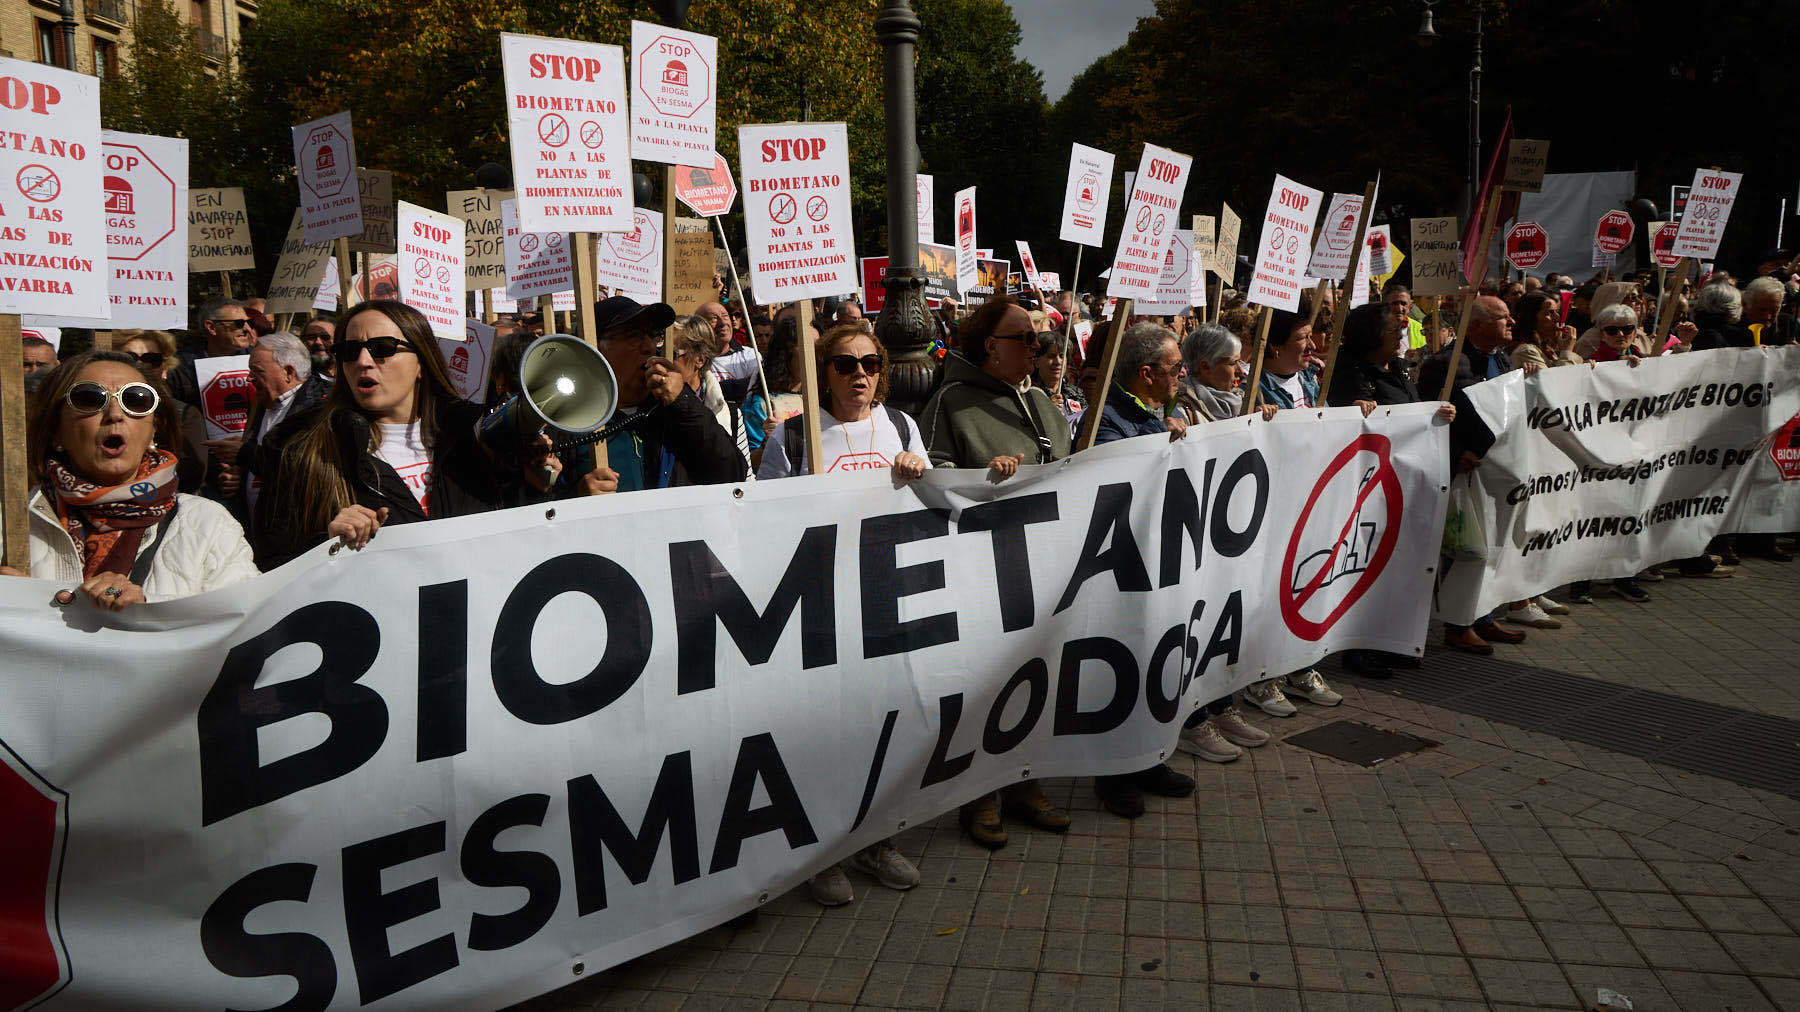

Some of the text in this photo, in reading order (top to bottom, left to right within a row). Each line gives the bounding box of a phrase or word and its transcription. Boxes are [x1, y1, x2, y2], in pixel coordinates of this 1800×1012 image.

[659, 42, 691, 58] STOP
[529, 53, 601, 82] STOP
[0, 76, 61, 115] OP
[661, 85, 689, 97] BIOGÁS
[516, 94, 616, 114] BIOMETANO
[657, 96, 693, 109] EN SESMA
[639, 117, 709, 134] NO A LA PLANTA
[311, 130, 334, 146] STOP
[636, 135, 710, 151] NAVARRA SE PLANTA
[539, 151, 606, 163] NO A LAS
[761, 138, 826, 163] STOP
[536, 168, 612, 180] PLANTAS DE
[1148, 158, 1180, 185] STOP
[750, 175, 840, 192] BIOMETANO
[1083, 177, 1096, 185] STOP
[1701, 175, 1731, 190] STOP
[196, 191, 222, 208] EN
[525, 186, 623, 198] BIOMETANIZACIÓN
[684, 186, 729, 199] BIOMETANO
[1134, 189, 1177, 210] BIOMETANO
[1279, 187, 1309, 211] STOP
[1691, 194, 1730, 205] BIOMETANO
[306, 206, 316, 215] NO
[332, 196, 356, 209] PLANTA
[463, 196, 492, 214] EN
[544, 205, 613, 216] EN NAVARRA
[1343, 204, 1361, 212] STOP
[27, 205, 63, 223] LAS
[1608, 215, 1627, 226] STOP
[1268, 212, 1308, 234] BIOMETANO
[1418, 220, 1448, 235] STOP
[47, 230, 73, 247] DE
[200, 227, 236, 241] STOP
[413, 221, 451, 245] STOP
[771, 224, 830, 238] NO A LAS
[1515, 228, 1537, 239] STOP
[1663, 227, 1677, 237] STO
[106, 234, 144, 246] ESMA
[768, 239, 835, 254] PLANTAS DE
[1132, 233, 1139, 242] NO
[1143, 236, 1147, 245] A
[1150, 237, 1160, 246] LAS
[1599, 235, 1626, 244] BIOMETANO
[190, 244, 253, 258] BIOMETANO
[405, 243, 458, 266] BIOMETANO
[549, 248, 564, 256] LAS
[1126, 247, 1158, 260] PLANTAS DE
[1510, 250, 1543, 259] BIOMETANO
[517, 258, 550, 271] PLANTAS
[758, 253, 846, 272] BIOMETANIZACIÓN
[1286, 256, 1295, 264] LAS
[115, 268, 175, 281] PLANTA
[280, 259, 318, 281] STOP
[511, 265, 572, 282] BIOMETANIZACIÓ
[1263, 261, 1295, 276] PLANTAS DE
[1414, 260, 1457, 280] SESMA
[415, 278, 424, 287] NO
[439, 284, 450, 292] LAS
[533, 276, 569, 288] NAVARRA
[775, 271, 837, 288] EN NAVARRA
[1120, 276, 1150, 289] EN NAVARRA
[411, 288, 453, 304] PLANTAS DE
[1260, 286, 1291, 300] EN NAVARRA
[128, 296, 177, 306] PLANTA
[1527, 406, 1564, 429] NO
[1672, 385, 1701, 411] DE
[1668, 449, 1686, 467] en
[1688, 445, 1719, 465] los
[1576, 514, 1643, 540] VAMOS
[199, 449, 1269, 827] BIOMETANO
[200, 590, 1243, 1012] SESMA / LODOSA
